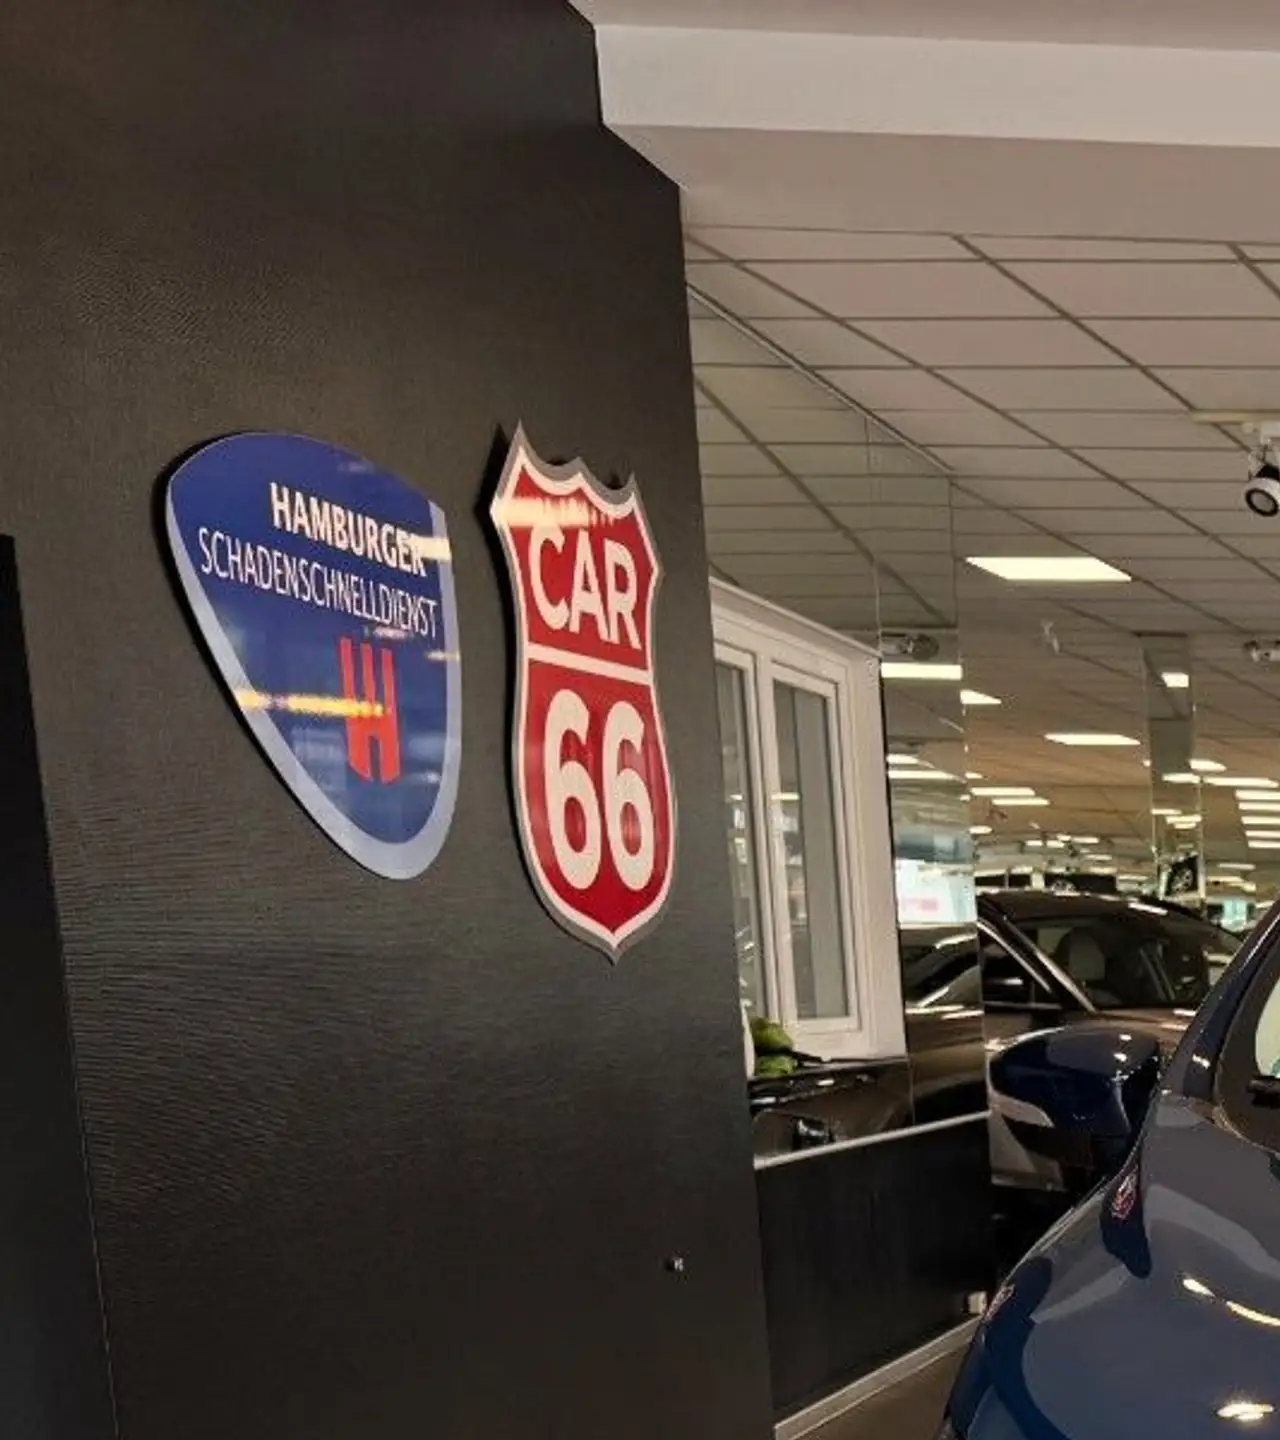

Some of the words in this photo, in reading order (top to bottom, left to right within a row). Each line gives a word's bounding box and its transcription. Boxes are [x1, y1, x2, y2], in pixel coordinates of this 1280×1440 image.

[200, 526, 437, 638] SCHADENSCHNELLDIENST
[270, 482, 427, 577] HAMBURGER
[529, 522, 642, 650] CAR
[545, 689, 654, 890] 66
